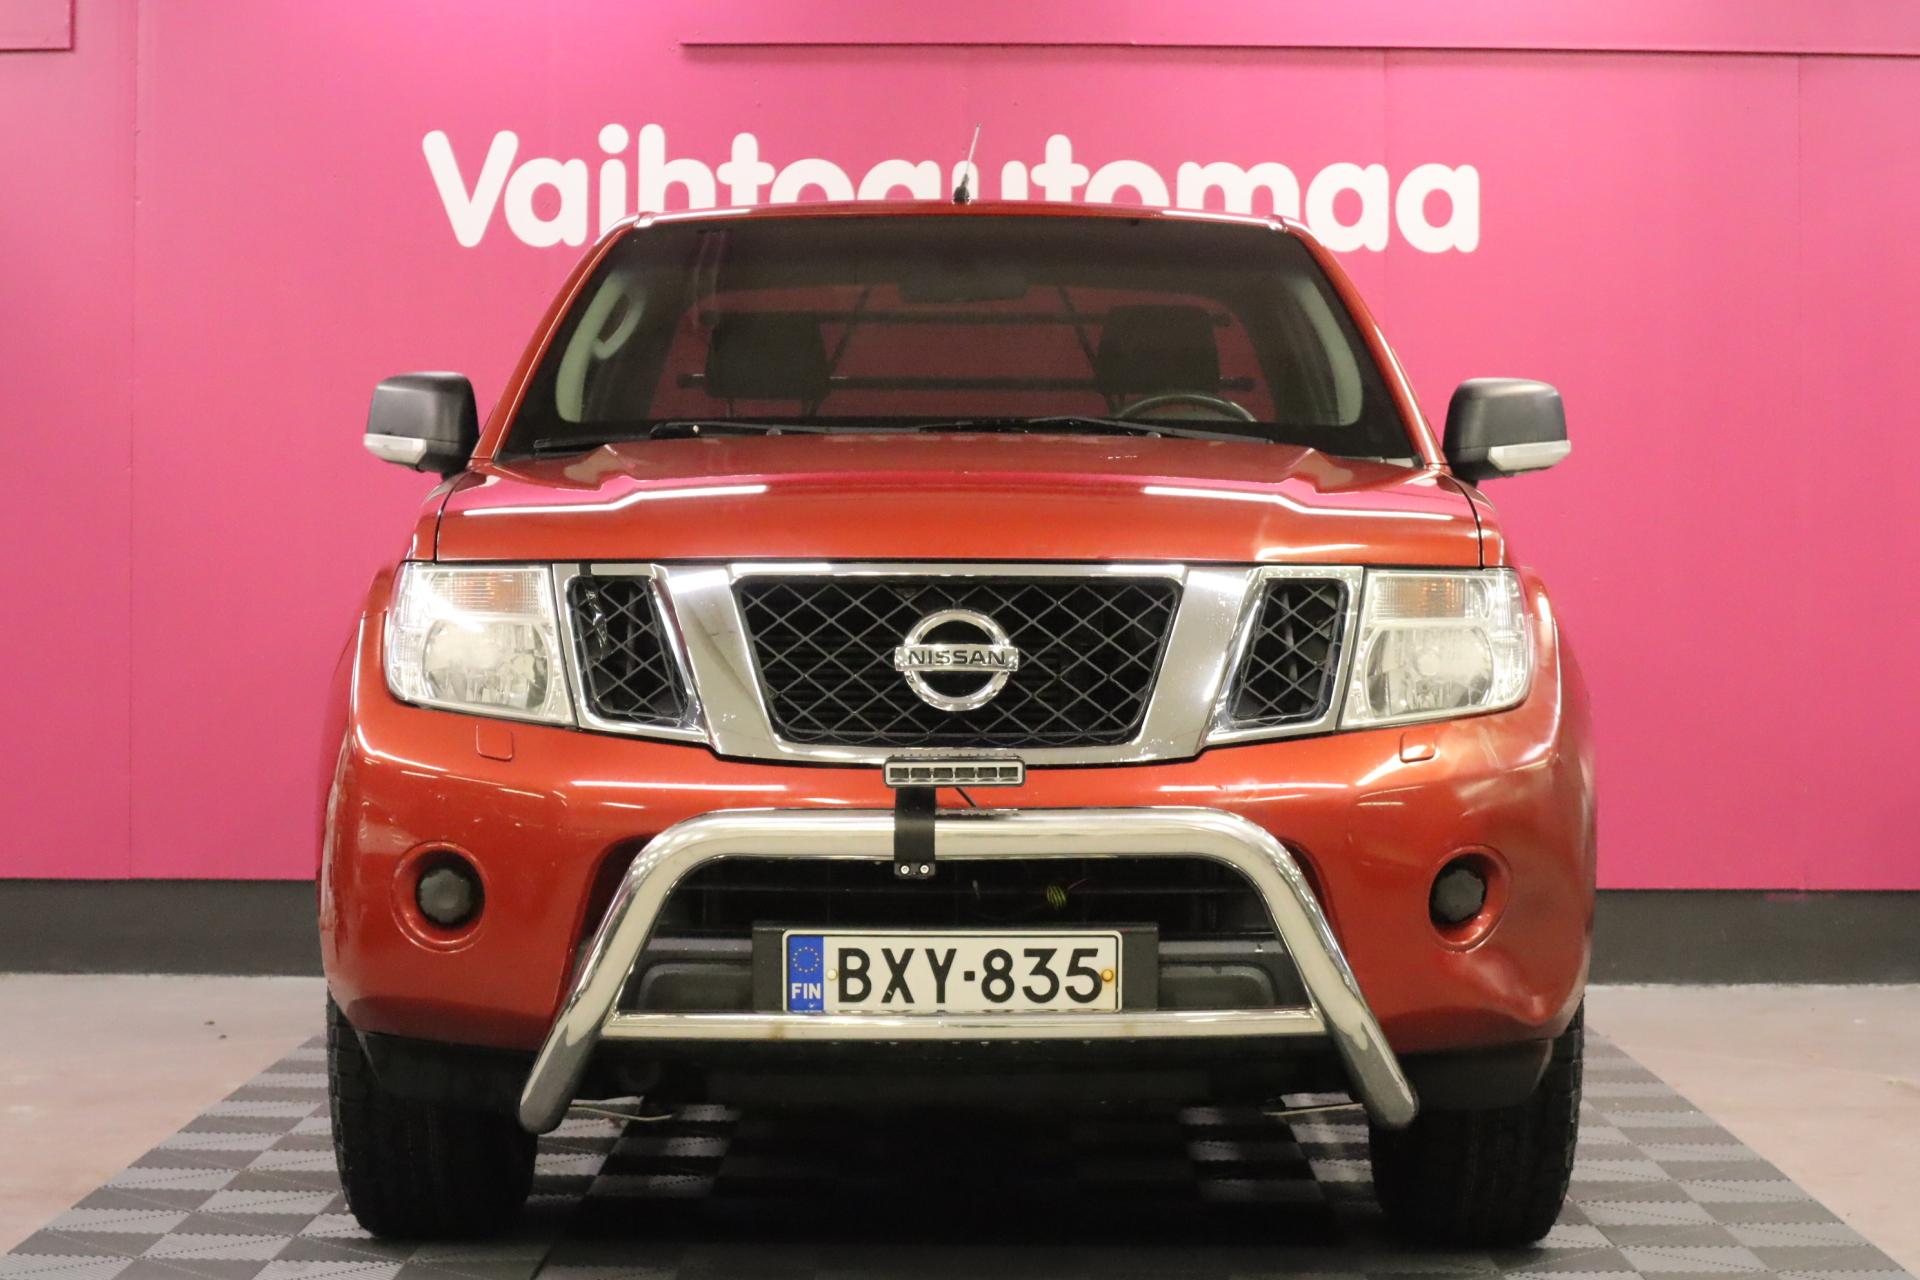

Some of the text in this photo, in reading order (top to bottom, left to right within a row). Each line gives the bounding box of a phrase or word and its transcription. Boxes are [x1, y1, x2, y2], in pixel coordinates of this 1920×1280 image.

[908, 649, 1006, 665] NISSAN
[791, 947, 1103, 1004] FIN BXY-835
